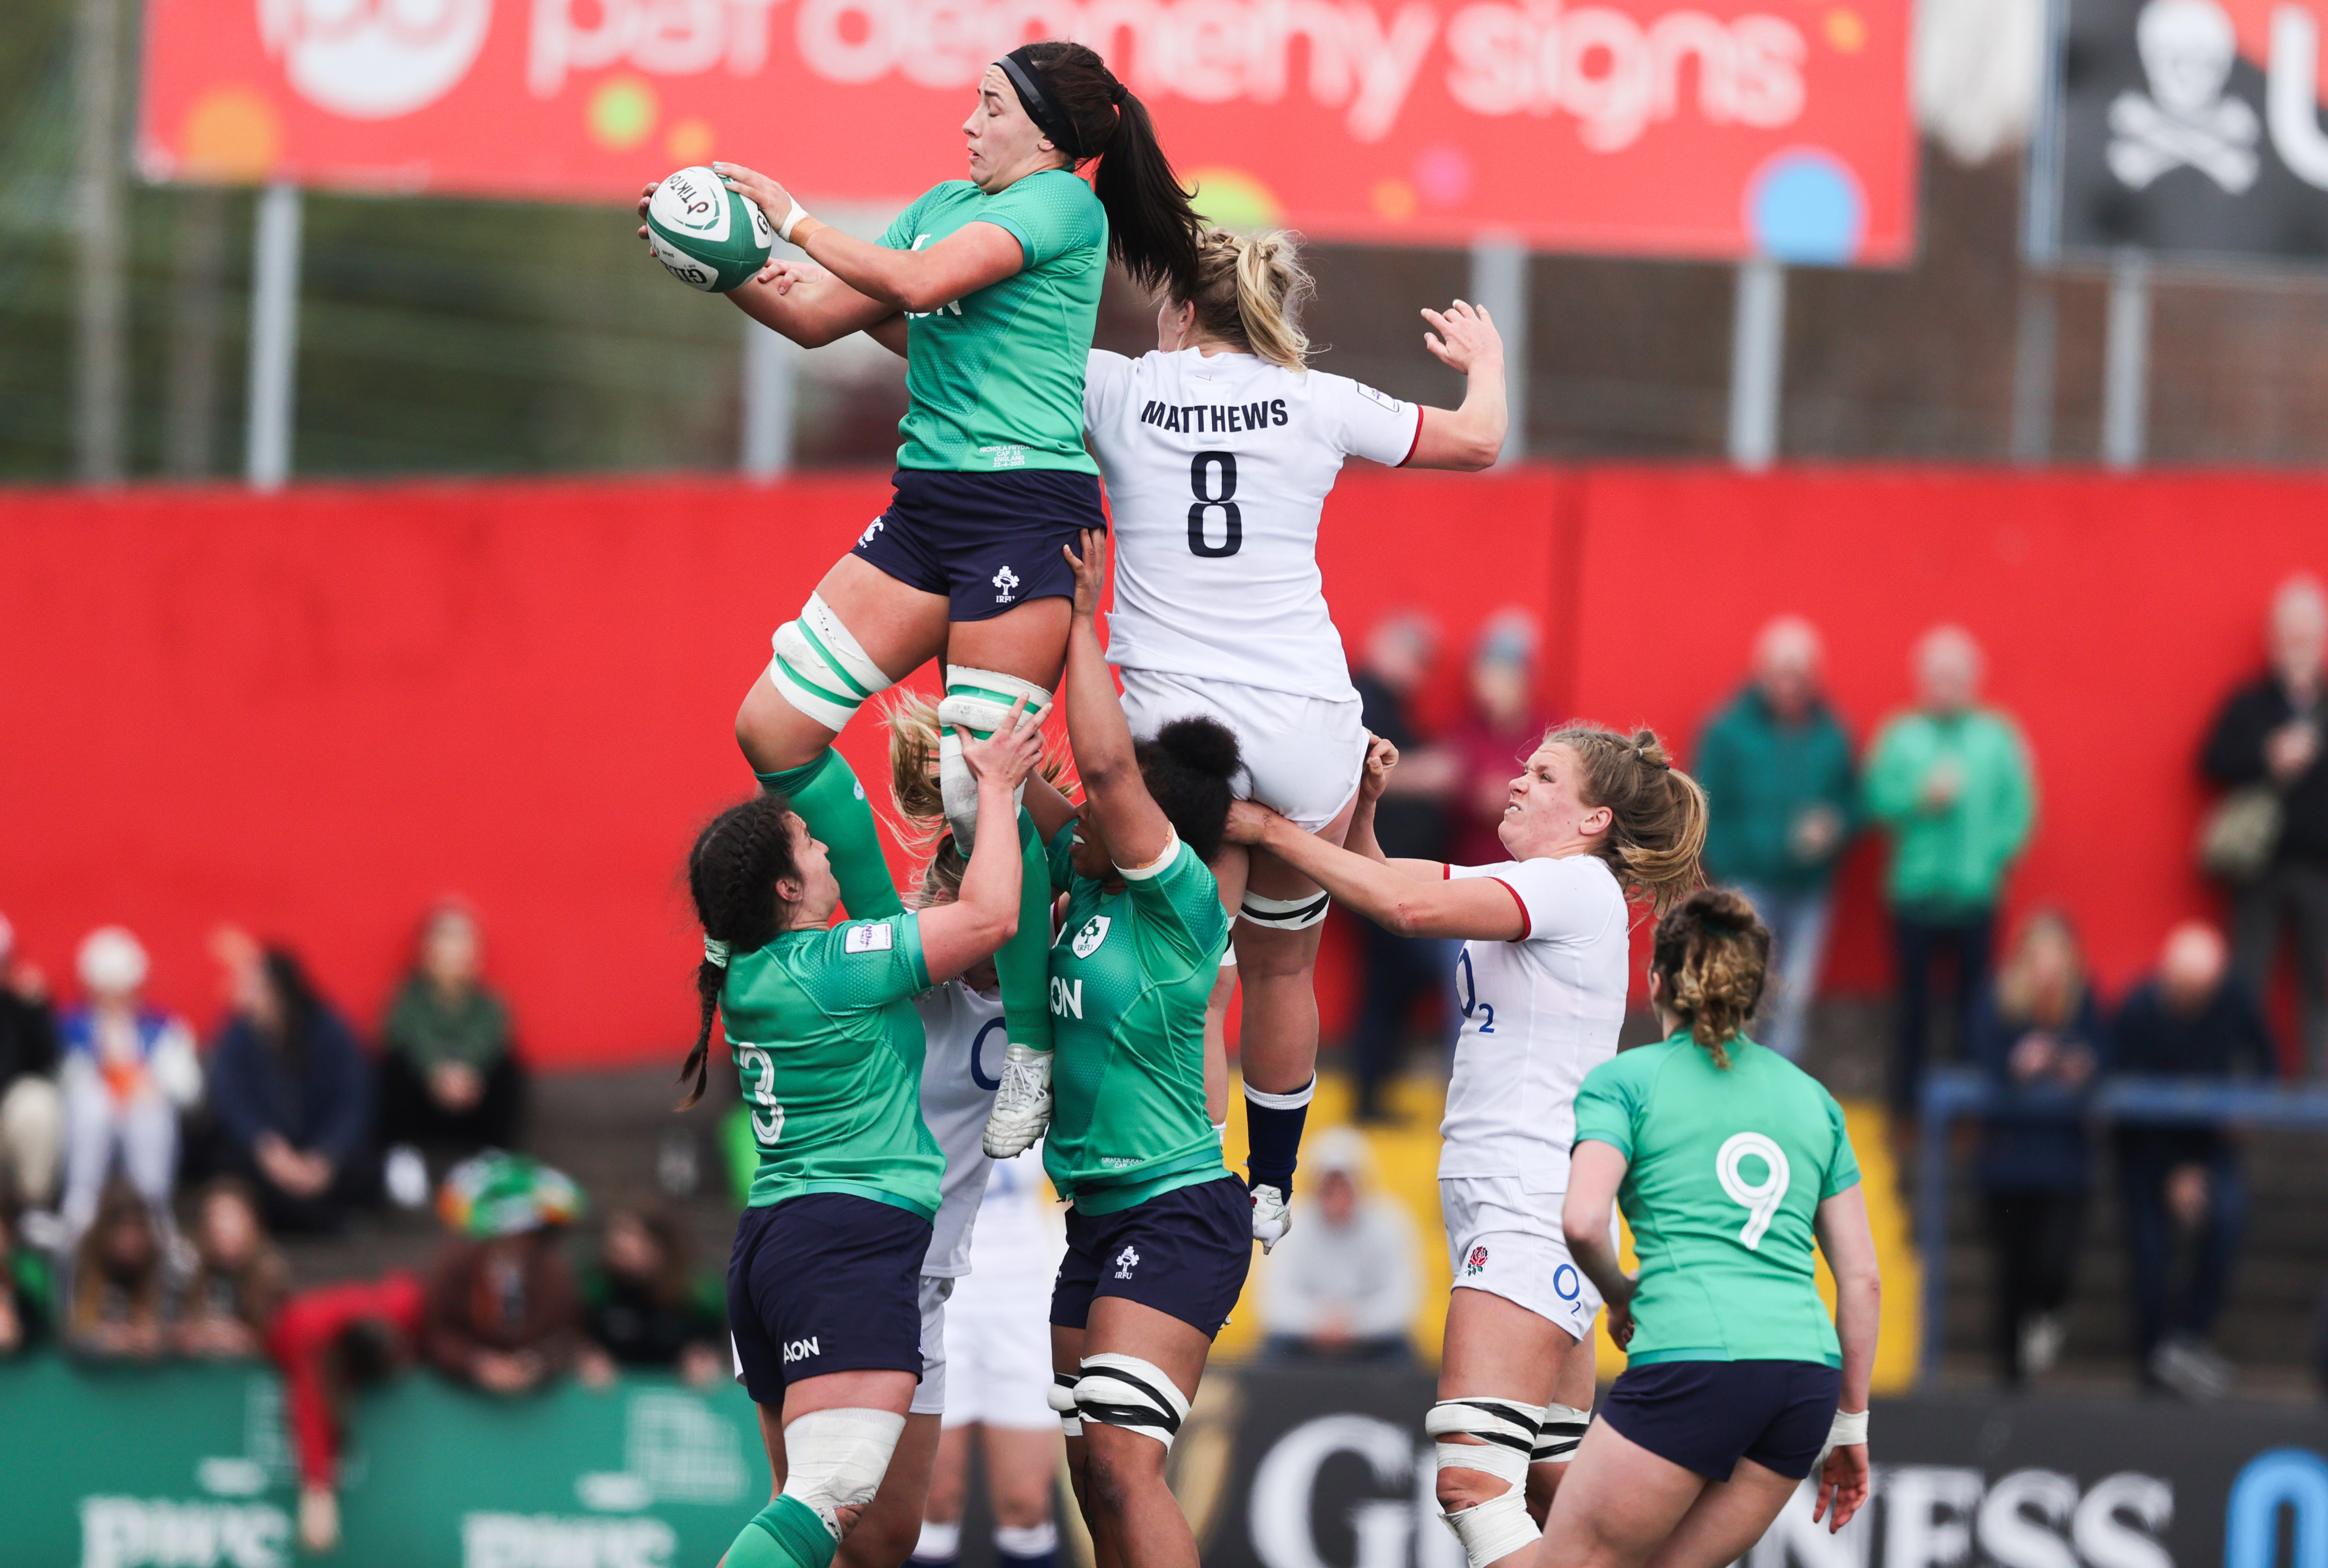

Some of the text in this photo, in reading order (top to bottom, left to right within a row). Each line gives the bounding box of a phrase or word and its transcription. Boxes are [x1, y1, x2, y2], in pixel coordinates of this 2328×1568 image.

[1445, 0, 1809, 154] signs
[1141, 399, 1288, 433] MATTHEWS
[1188, 451, 1242, 558] 8
[1050, 976, 1083, 1019] ON
[738, 1042, 785, 1145] 3
[1716, 1131, 1790, 1251] 9
[783, 1336, 820, 1365] AON
